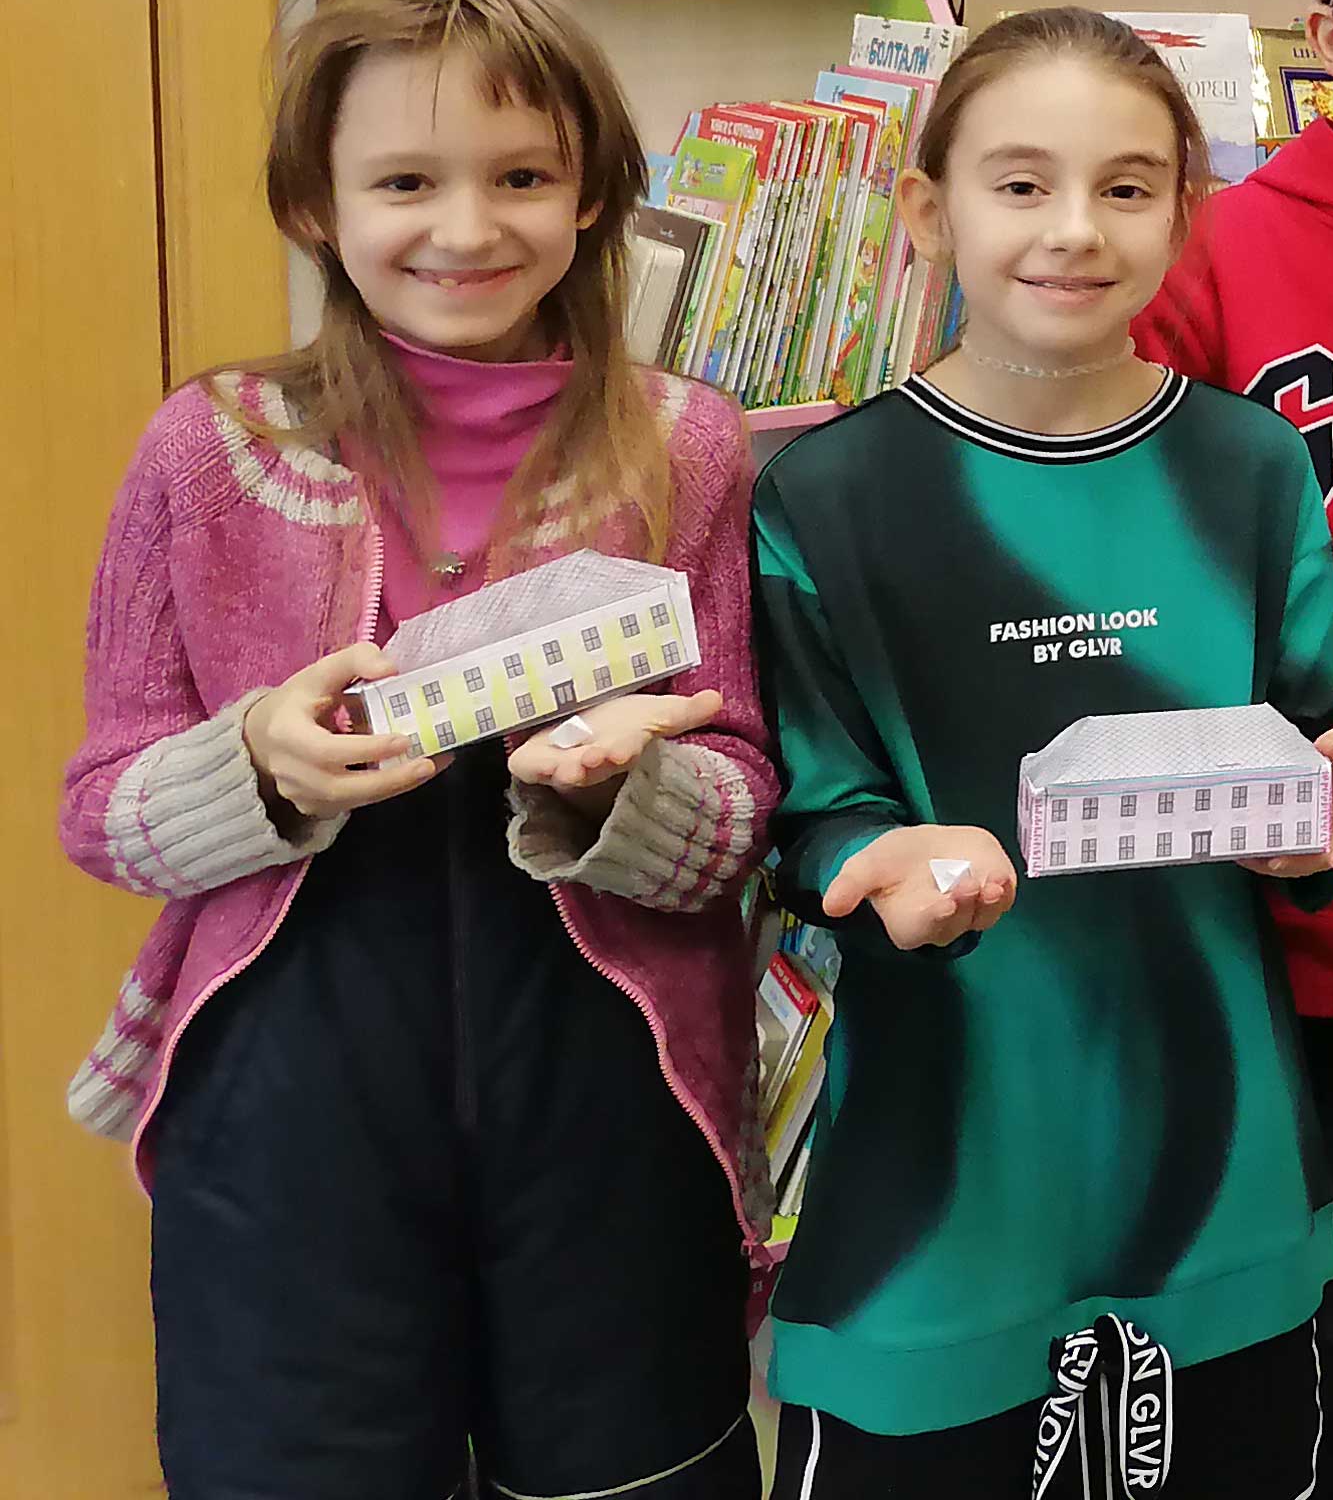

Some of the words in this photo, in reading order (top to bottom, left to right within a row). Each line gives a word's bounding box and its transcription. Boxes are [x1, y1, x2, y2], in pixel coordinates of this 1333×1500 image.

[989, 612, 1095, 643] FASHION
[1100, 607, 1159, 631] LOOK
[1033, 641, 1062, 664] BY
[1068, 636, 1122, 659] GLVR
[1128, 1393, 1162, 1489] GLVR
